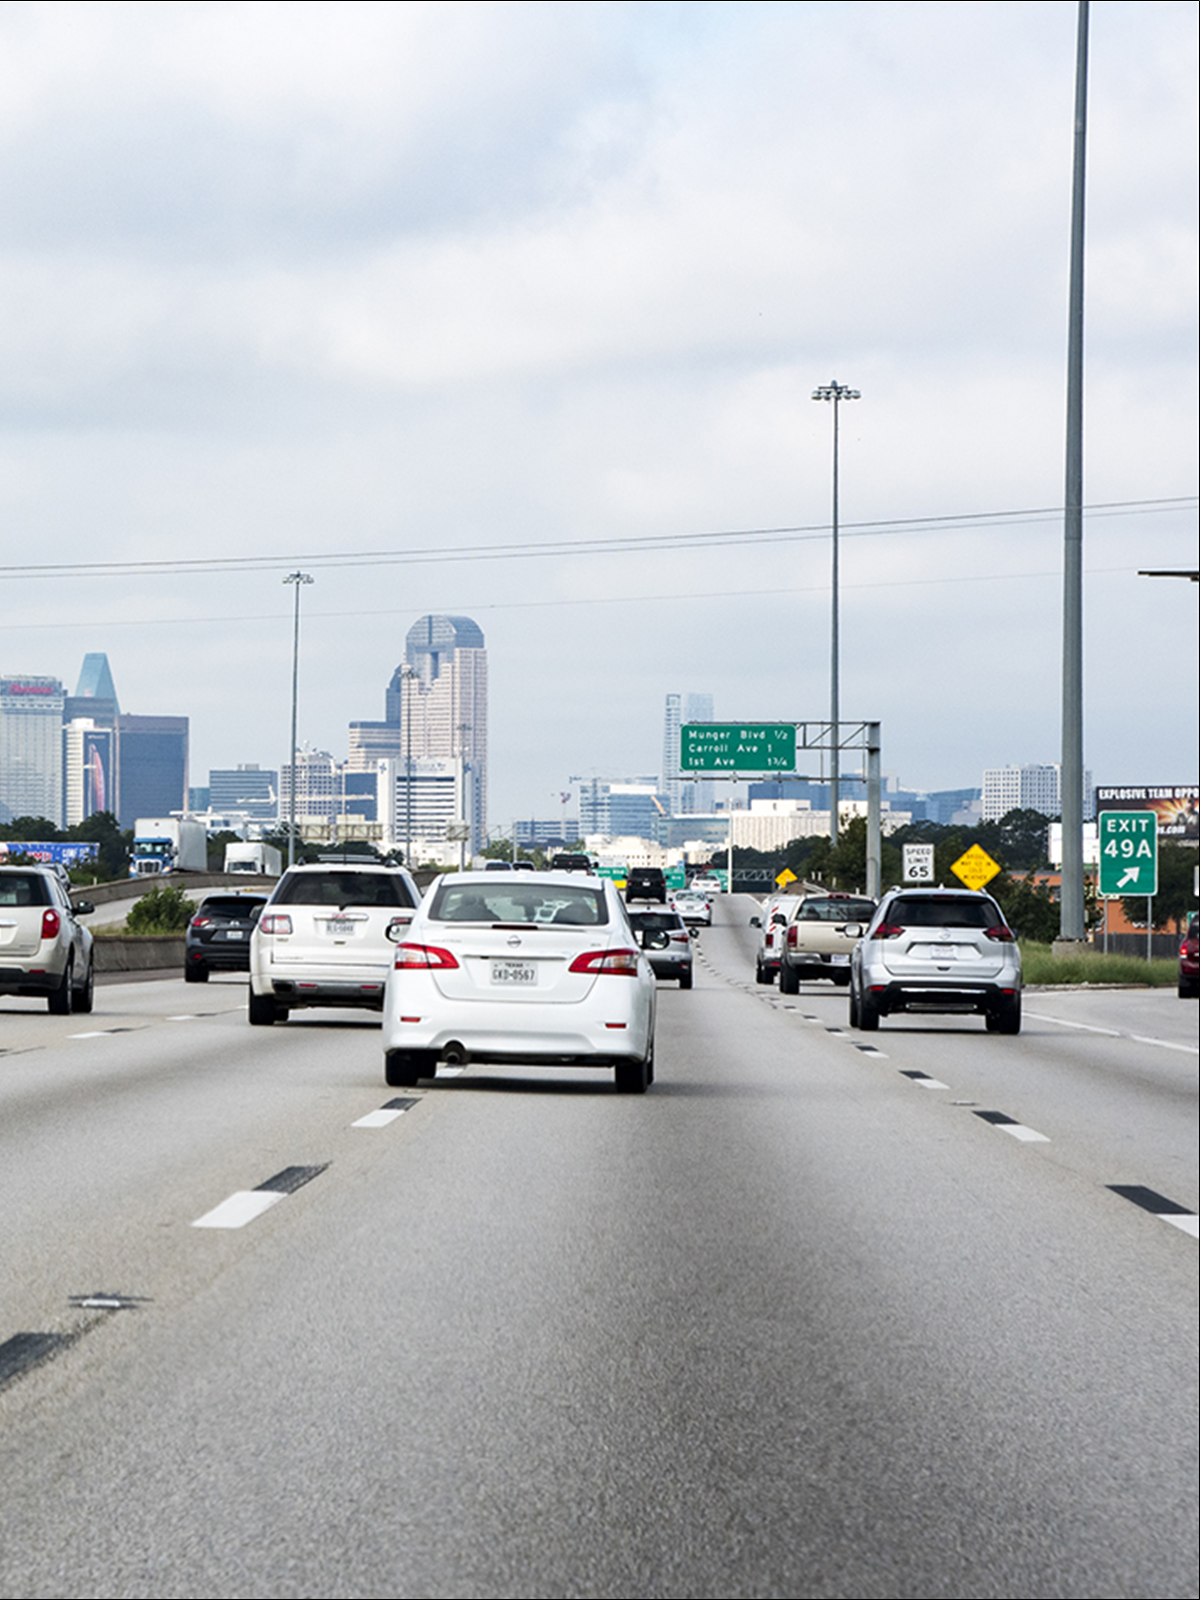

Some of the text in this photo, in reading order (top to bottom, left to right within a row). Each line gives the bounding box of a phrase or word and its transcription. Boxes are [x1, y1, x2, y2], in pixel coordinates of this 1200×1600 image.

[688, 730, 731, 741] Munger
[740, 730, 766, 740] Blvd
[688, 744, 773, 753] Carroll Ave 1
[688, 757, 704, 766] 1st
[714, 757, 735, 766] Ave
[1099, 788, 1147, 799] EXPLOSIVE
[1148, 788, 1173, 799] TEAM
[1107, 819, 1149, 832] EXIT
[1104, 839, 1152, 858] 49A
[908, 866, 929, 878] 65
